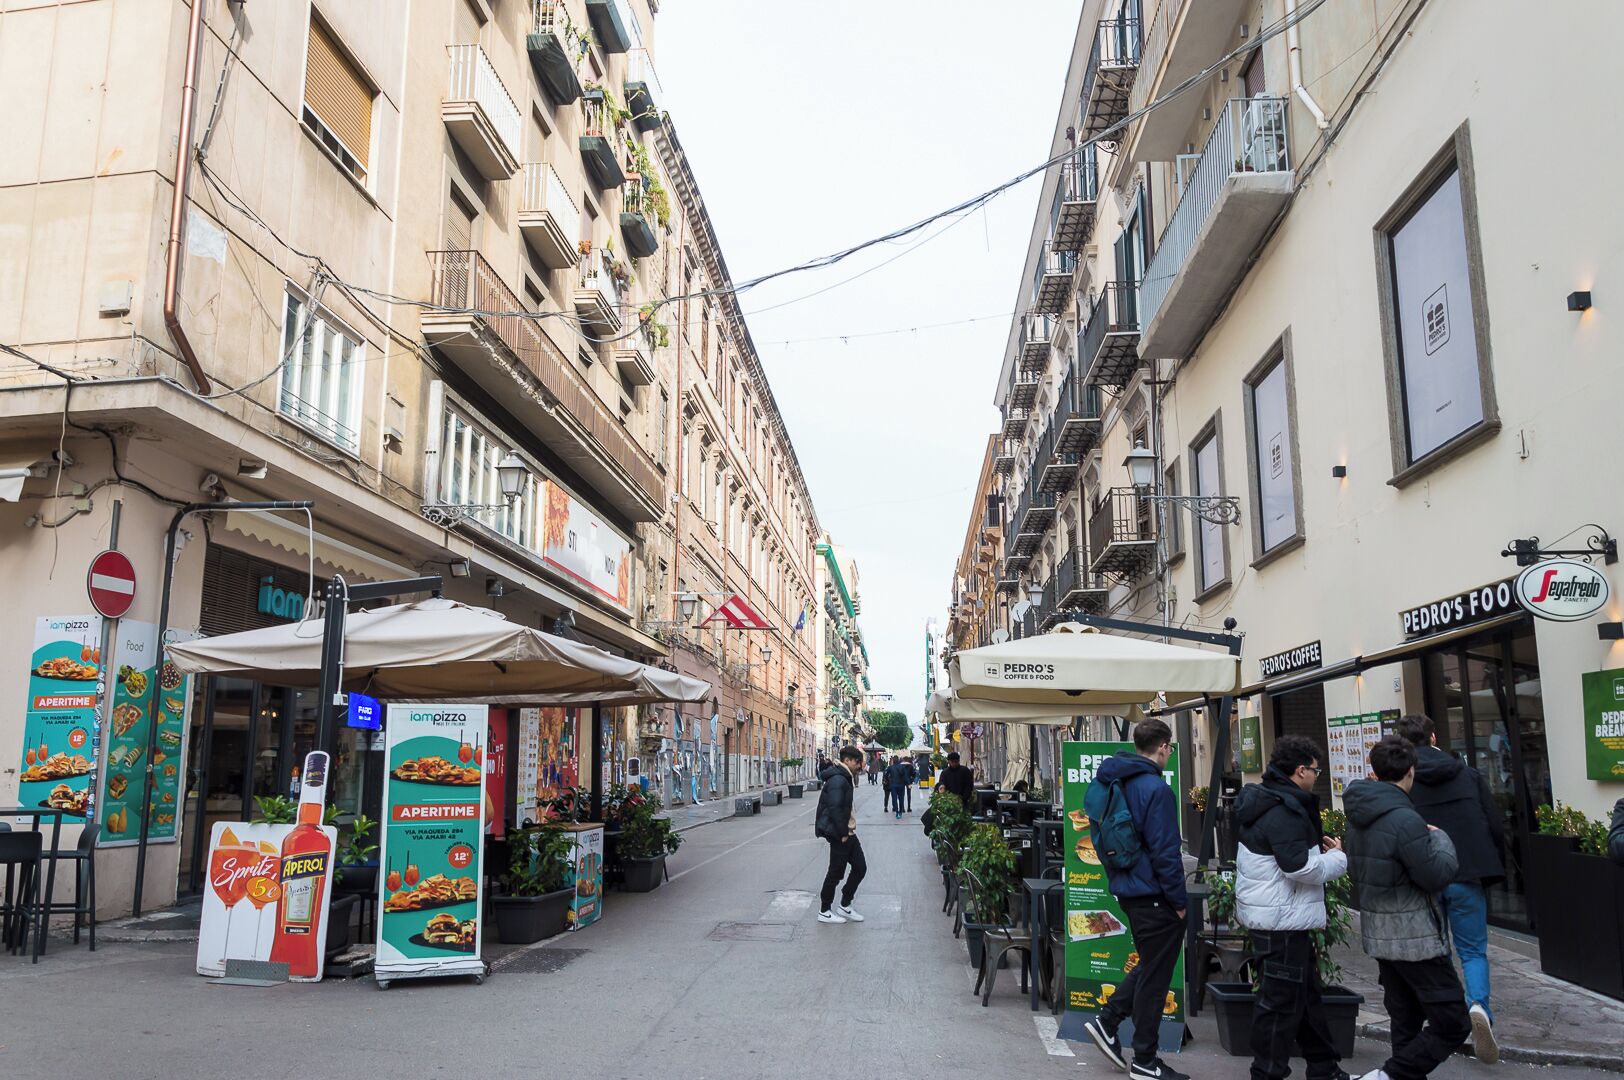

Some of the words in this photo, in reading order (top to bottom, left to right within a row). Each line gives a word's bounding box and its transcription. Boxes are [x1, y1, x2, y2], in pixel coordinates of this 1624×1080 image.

[1531, 569, 1600, 603] Segafredo
[1403, 595, 1465, 634] PEDRO'S
[1470, 581, 1518, 616] FOO
[50, 619, 89, 632] iampizza
[1261, 652, 1292, 675] PEDRO'S
[1291, 643, 1321, 668] COFFEE
[1004, 663, 1055, 674] PEDRO'S
[39, 697, 90, 707] APERITIME
[410, 711, 467, 726] iampizza
[400, 806, 475, 818] APERITIME
[282, 857, 324, 878] APEROL
